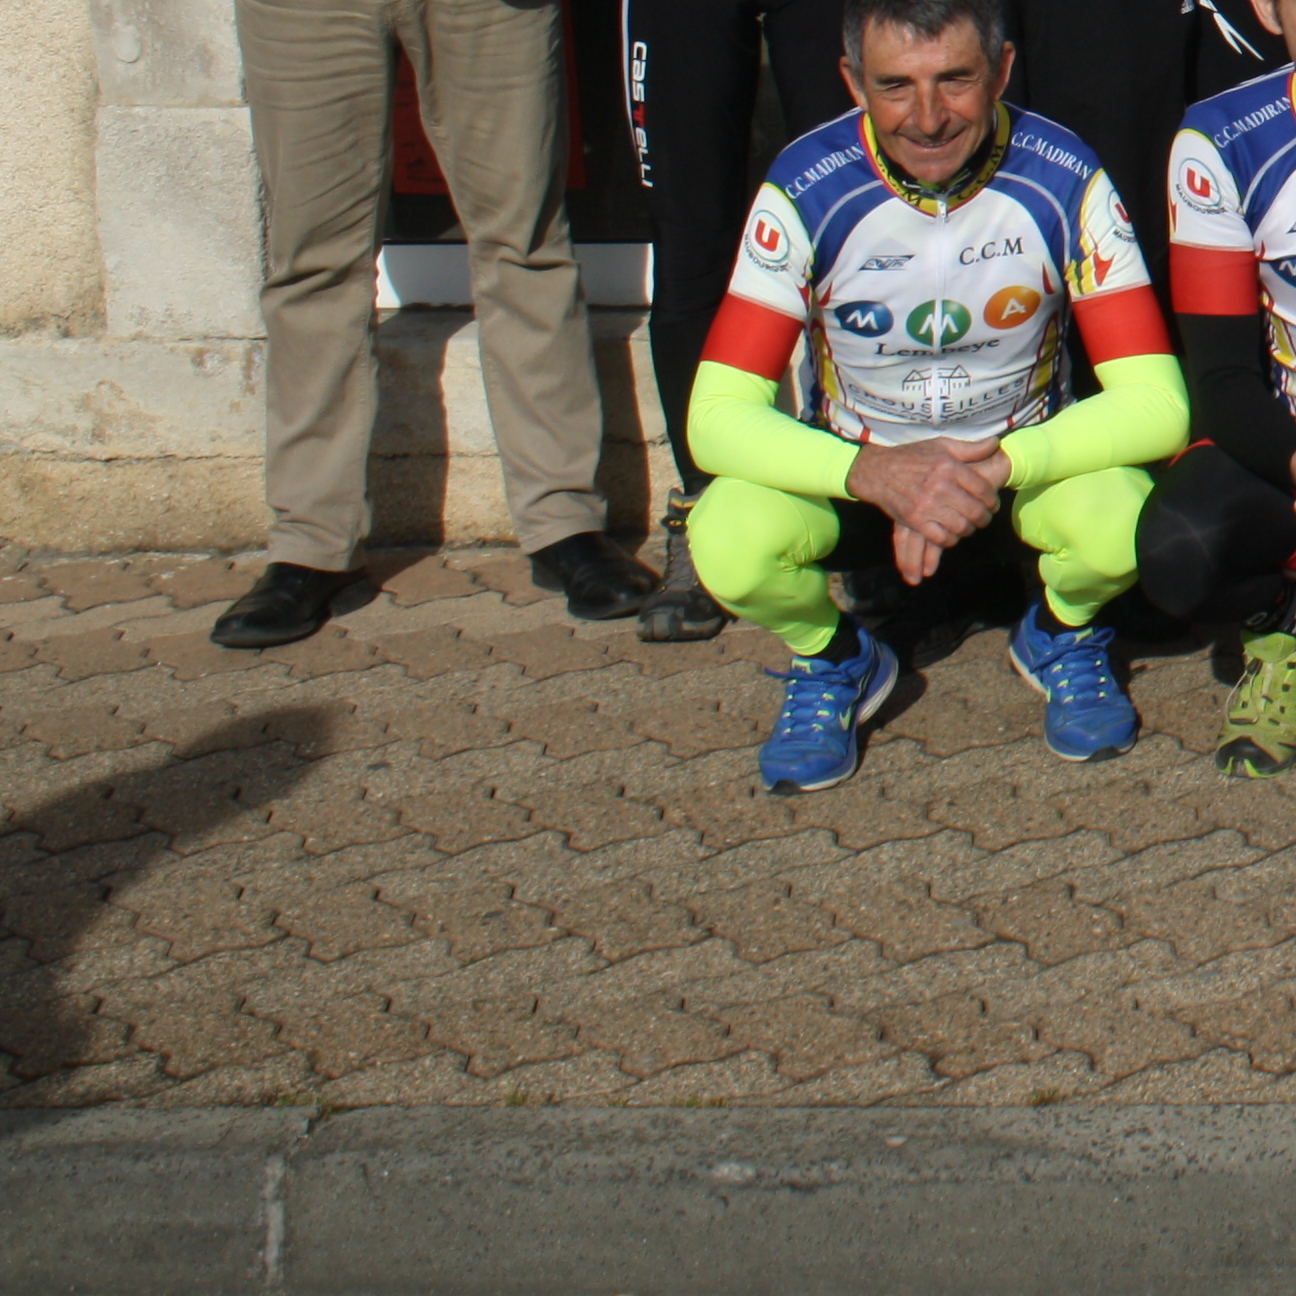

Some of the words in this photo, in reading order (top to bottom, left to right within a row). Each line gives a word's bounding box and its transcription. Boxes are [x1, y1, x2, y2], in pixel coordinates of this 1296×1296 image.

[1214, 95, 1292, 151] C.C.MADIRAN
[785, 143, 864, 200] C.C.MADIRAN
[1010, 132, 1093, 182] C.C.MADIRAN
[1185, 166, 1212, 198] U
[754, 218, 781, 253] U
[958, 236, 1025, 265] C.C.M
